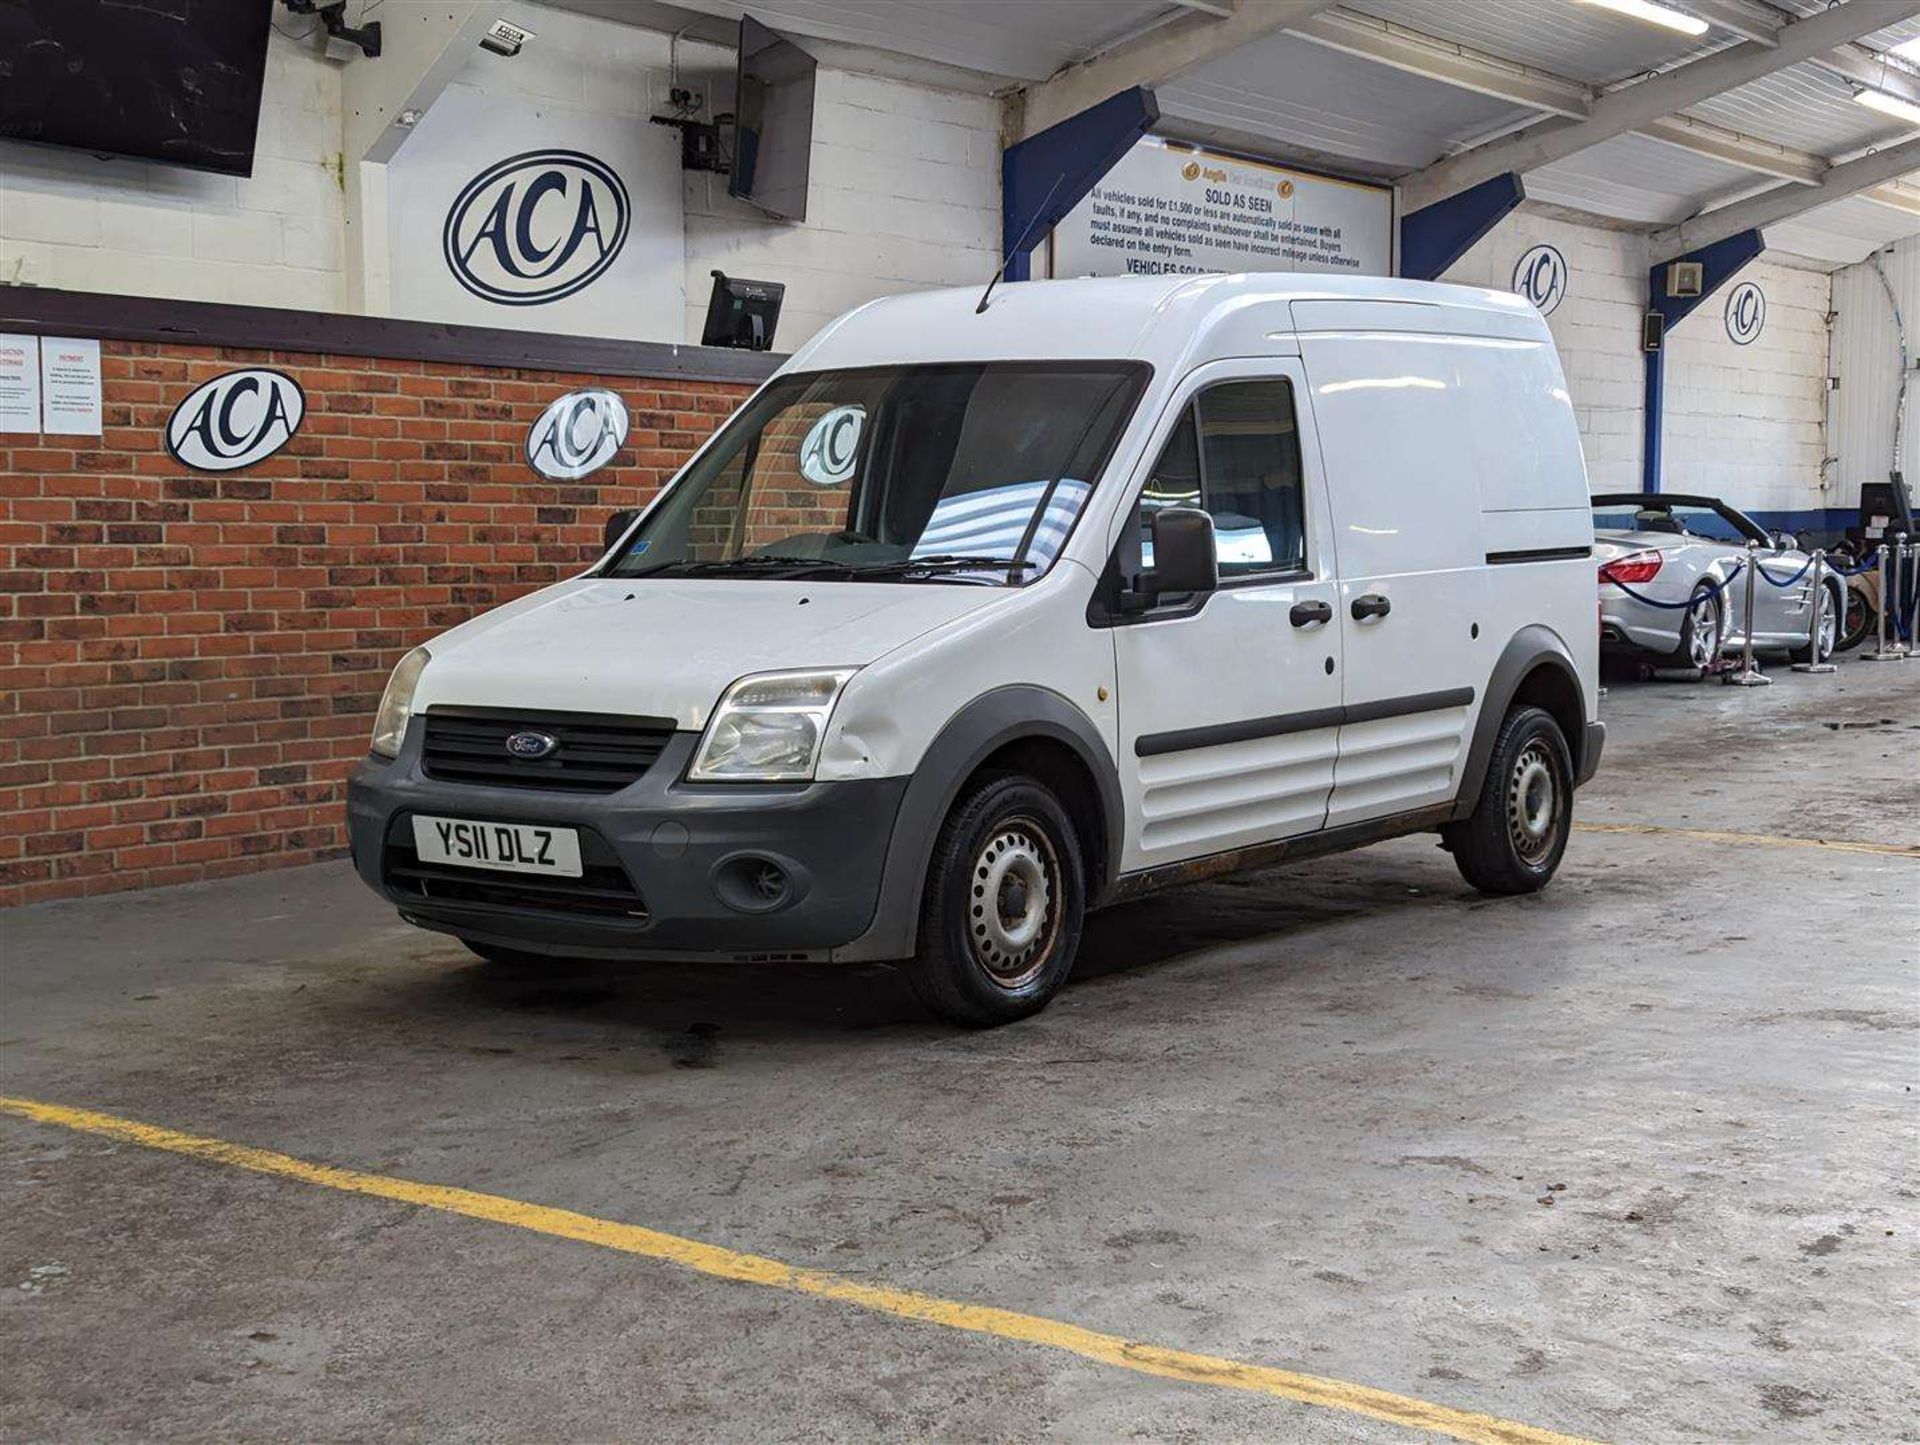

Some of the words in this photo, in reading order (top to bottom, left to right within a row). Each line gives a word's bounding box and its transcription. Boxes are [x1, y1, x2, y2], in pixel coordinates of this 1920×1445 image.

[1091, 187, 1101, 198] All
[1103, 190, 1136, 205] vehicles
[1138, 196, 1154, 208] sold
[1156, 198, 1167, 209] for
[1194, 207, 1201, 215] or
[1203, 206, 1218, 218] less
[1220, 210, 1230, 220] are
[1233, 212, 1277, 230] automatically
[1205, 188, 1231, 206] SOLD
[1233, 194, 1245, 208] AS
[1248, 196, 1272, 213] SEEN
[461, 170, 606, 279] ACA
[1091, 220, 1110, 231] must
[1113, 223, 1142, 236] assume
[1145, 226, 1153, 237] all
[1155, 228, 1186, 242] vehicles
[1188, 234, 1203, 244] sold
[1205, 237, 1213, 246] as
[1215, 239, 1231, 249] seen
[1233, 240, 1249, 252] have
[1251, 242, 1280, 256] incorrect
[1308, 252, 1328, 263] unless
[1331, 255, 1359, 268] otherwise
[1091, 233, 1124, 248] declared
[1126, 240, 1136, 249] on
[1138, 240, 1150, 252] the
[1153, 244, 1171, 257] entry
[1119, 206, 1125, 218] if
[1145, 213, 1158, 223] and
[1161, 216, 1170, 225] no
[1172, 218, 1210, 231] complaints
[1213, 222, 1252, 237] whatsoever
[1253, 229, 1269, 241] shall
[1271, 232, 1279, 242] be
[1126, 258, 1177, 275] VEHICLES
[1519, 253, 1559, 308] ACA
[1728, 289, 1759, 336] ACA
[175, 377, 293, 458] ACA
[531, 397, 621, 468] ACA
[515, 737, 539, 751] Ford
[436, 821, 489, 861] YS11
[495, 827, 555, 866] DLZ
